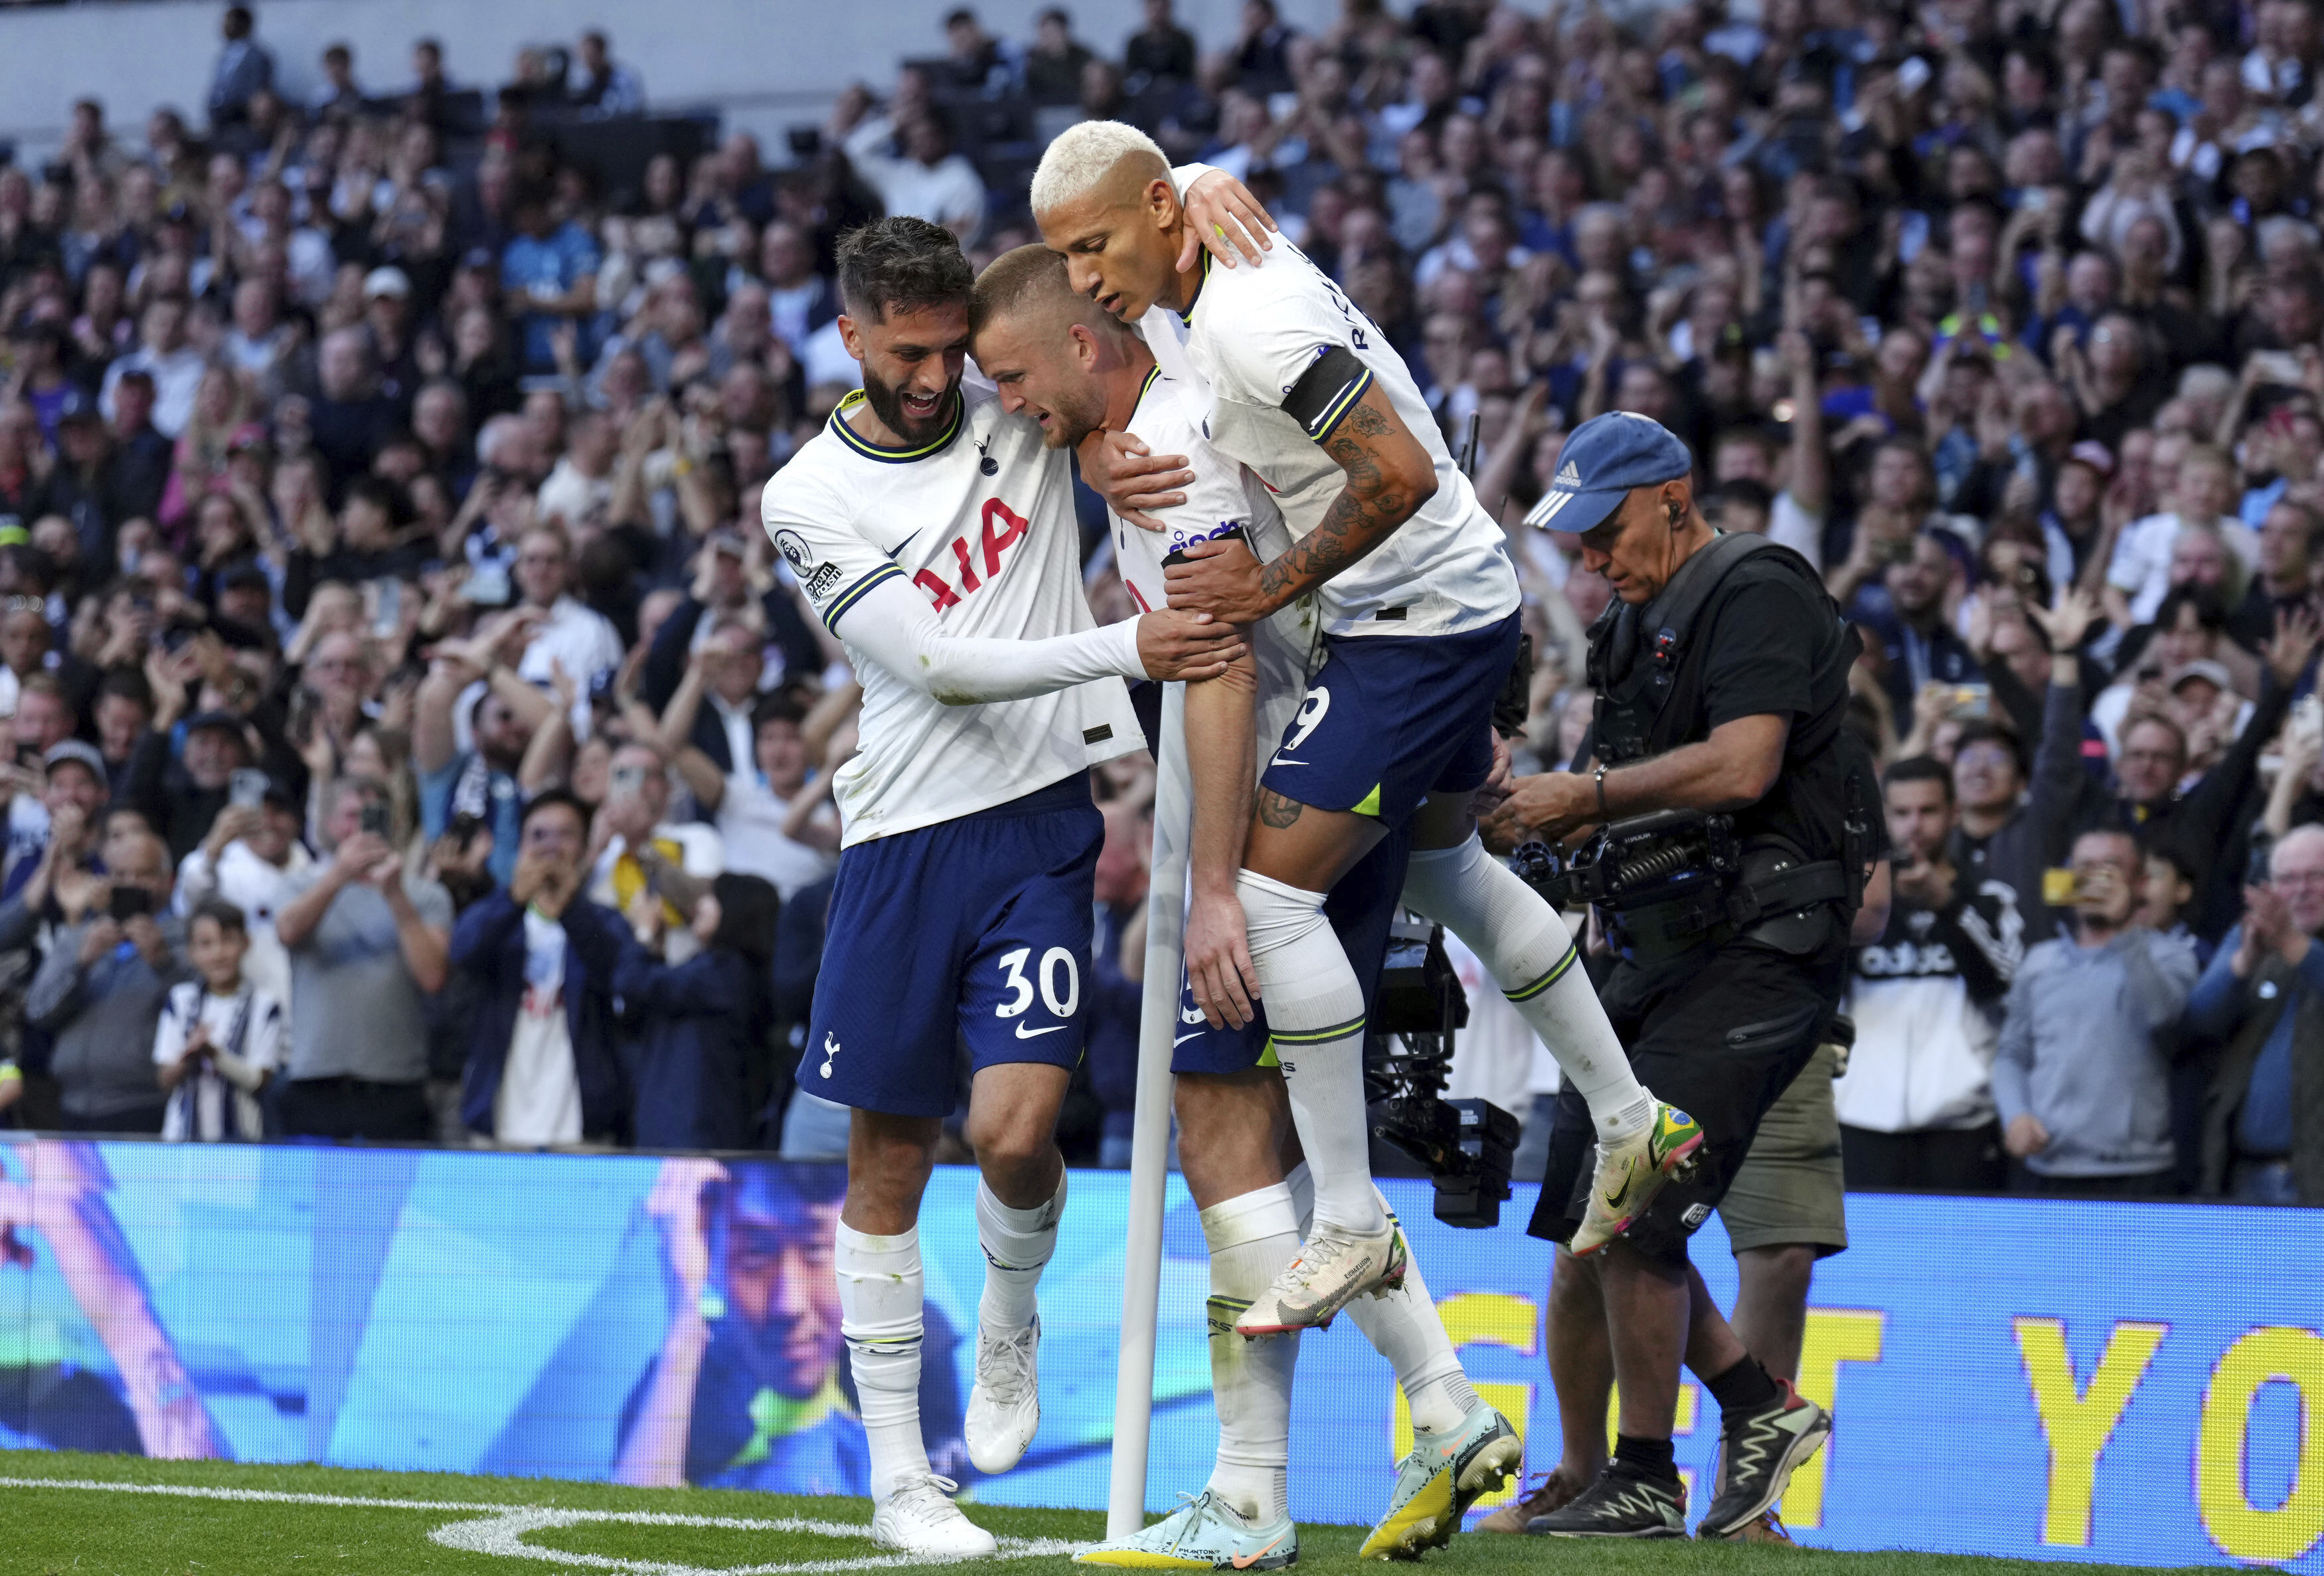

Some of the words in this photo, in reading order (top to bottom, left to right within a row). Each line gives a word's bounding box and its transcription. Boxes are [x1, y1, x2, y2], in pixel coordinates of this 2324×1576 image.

[813, 566, 833, 589] room
[913, 497, 1029, 614] AIA
[1284, 685, 1330, 750] 9
[996, 946, 1079, 1017] 30
[1344, 1255, 1371, 1280] RICHARLISON
[1394, 1292, 1884, 1528] GT
